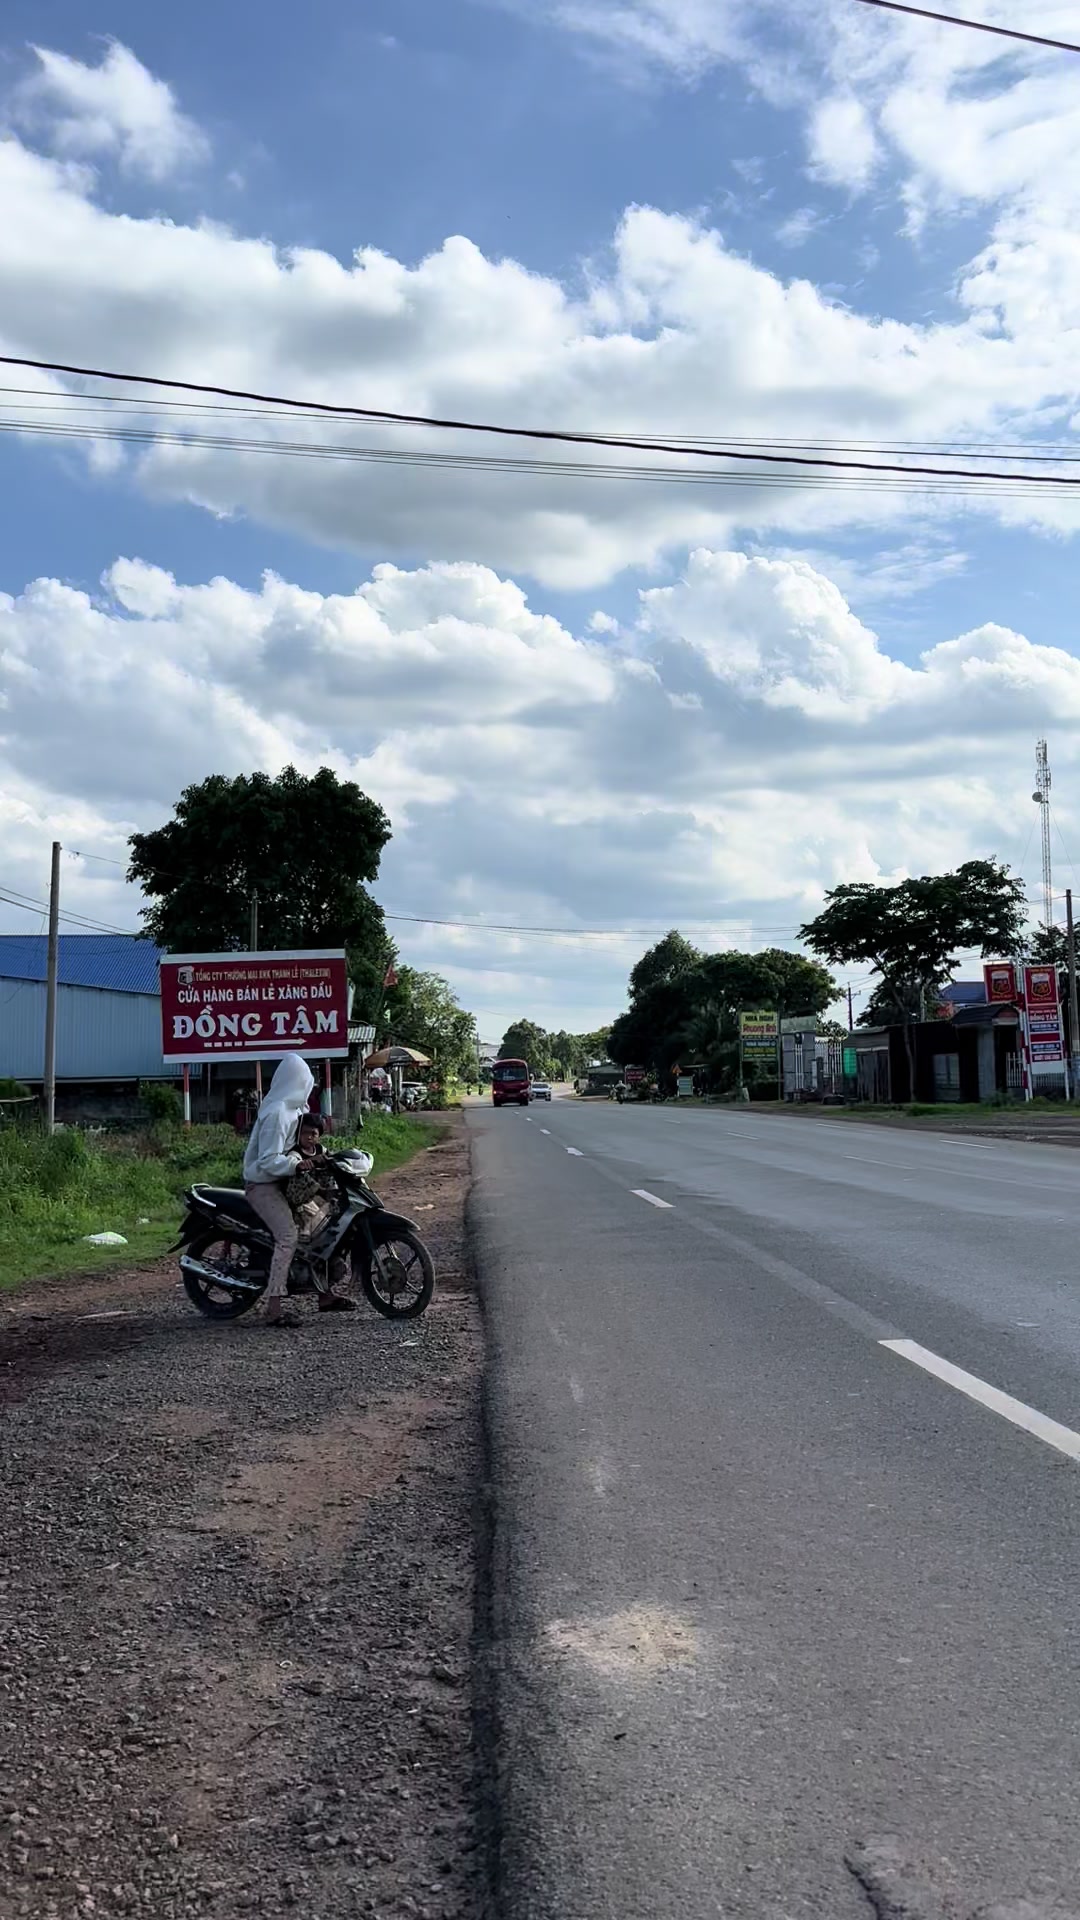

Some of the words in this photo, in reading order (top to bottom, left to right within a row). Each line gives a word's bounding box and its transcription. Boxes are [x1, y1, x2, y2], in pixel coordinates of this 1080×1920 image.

[212, 971, 223, 981] CTY
[178, 984, 200, 1003] CỬA
[203, 986, 234, 1002] HÀNG
[237, 985, 259, 1001] BÁN
[262, 982, 275, 1000] LẺ
[278, 984, 308, 999] XĂNG
[172, 1004, 263, 1039] ĐỒNG
[270, 1005, 339, 1035] TÂM
